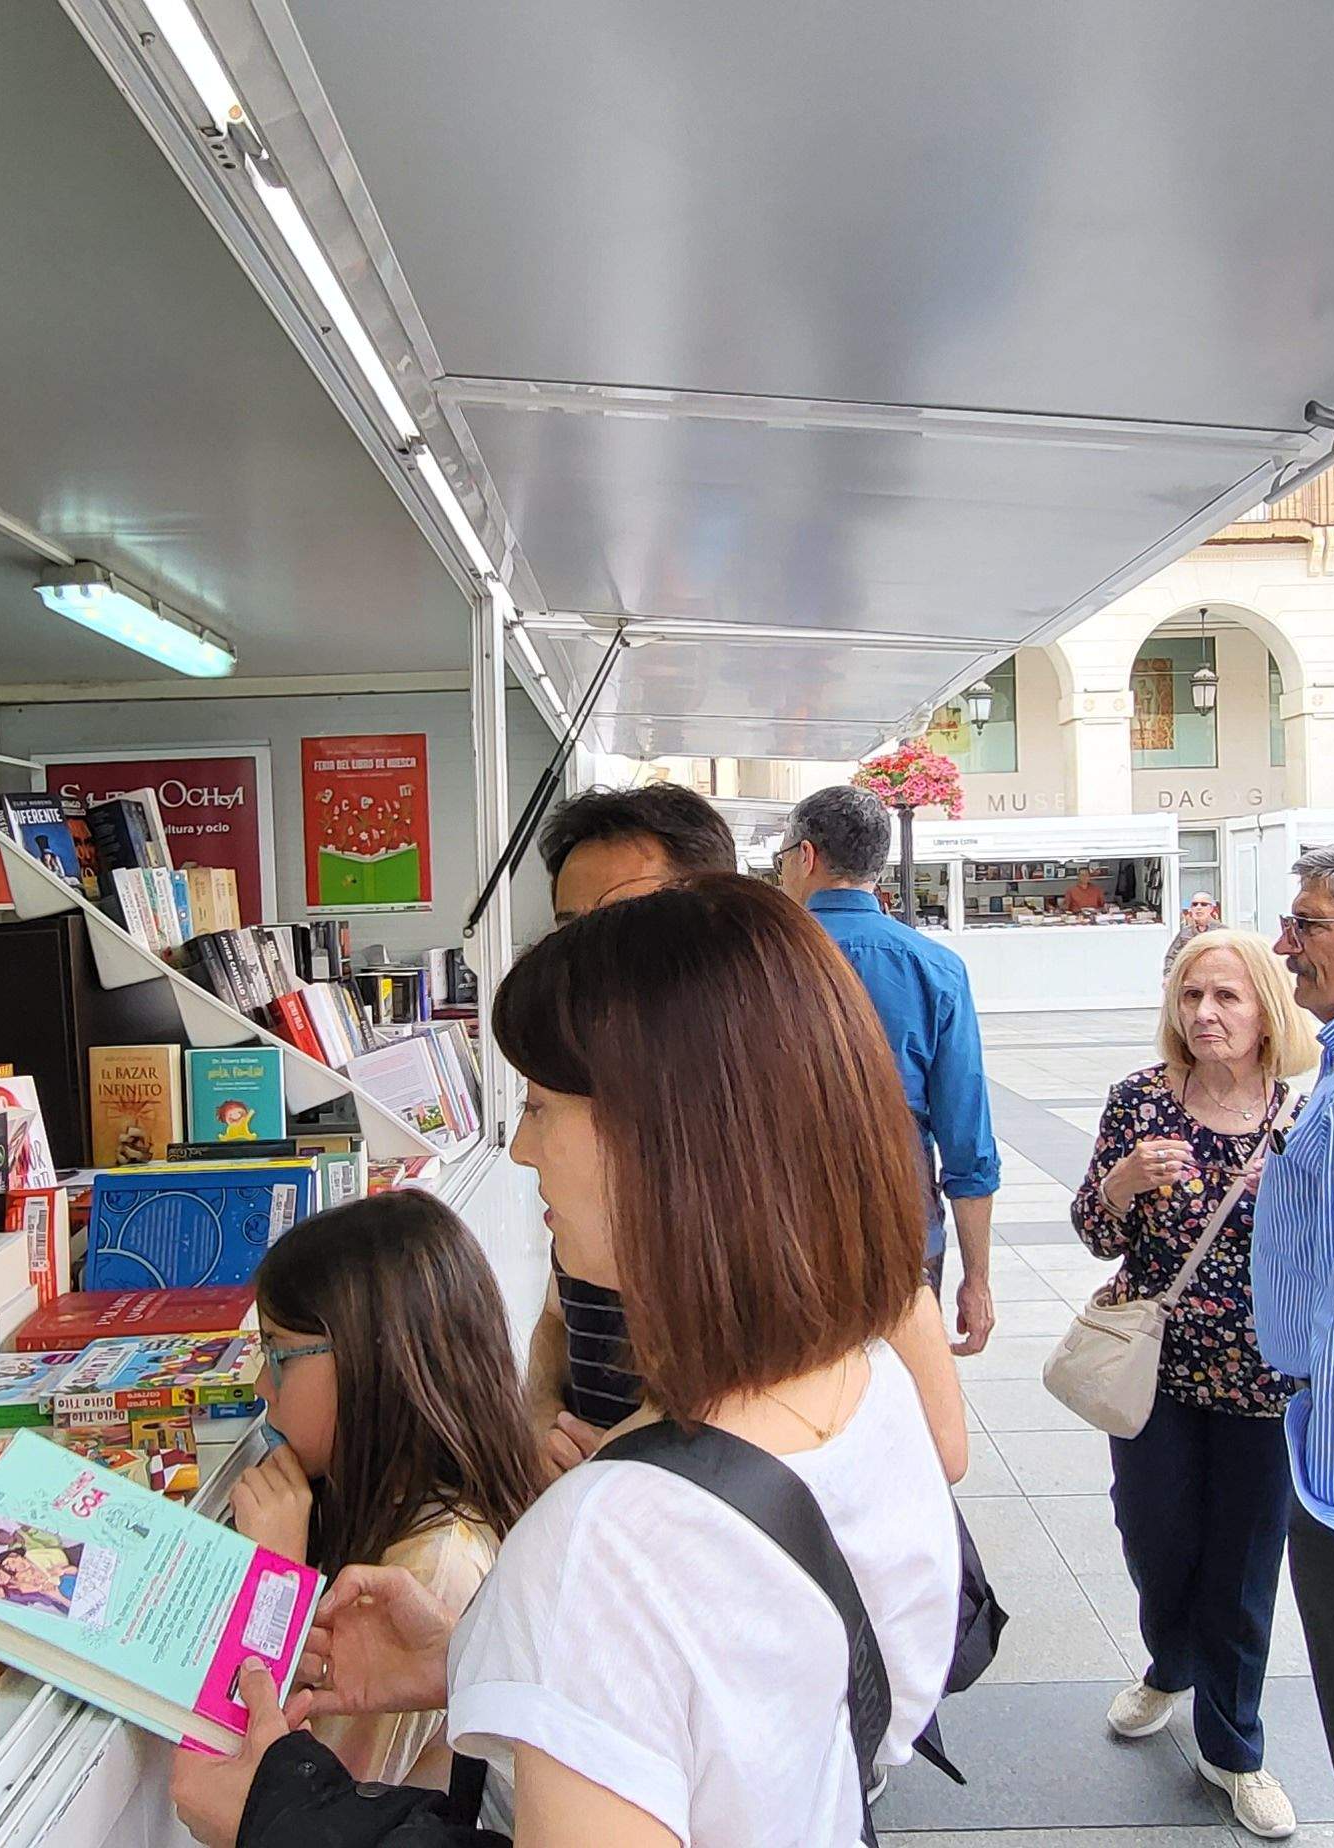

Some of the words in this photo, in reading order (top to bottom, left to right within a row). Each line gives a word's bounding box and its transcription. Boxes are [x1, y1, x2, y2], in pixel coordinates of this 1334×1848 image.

[12, 808, 64, 826] DIFERENTE
[165, 824, 194, 835] ultura
[205, 823, 230, 833] ocio
[219, 935, 234, 962] JAVIER
[229, 960, 246, 996] CASTILLO
[115, 1066, 159, 1080] BAZAR
[98, 1083, 162, 1097] INFINITO
[57, 1396, 80, 1410] Tito
[83, 1395, 114, 1409] Osito
[71, 1410, 95, 1423] Tito
[96, 1408, 126, 1422] Osito
